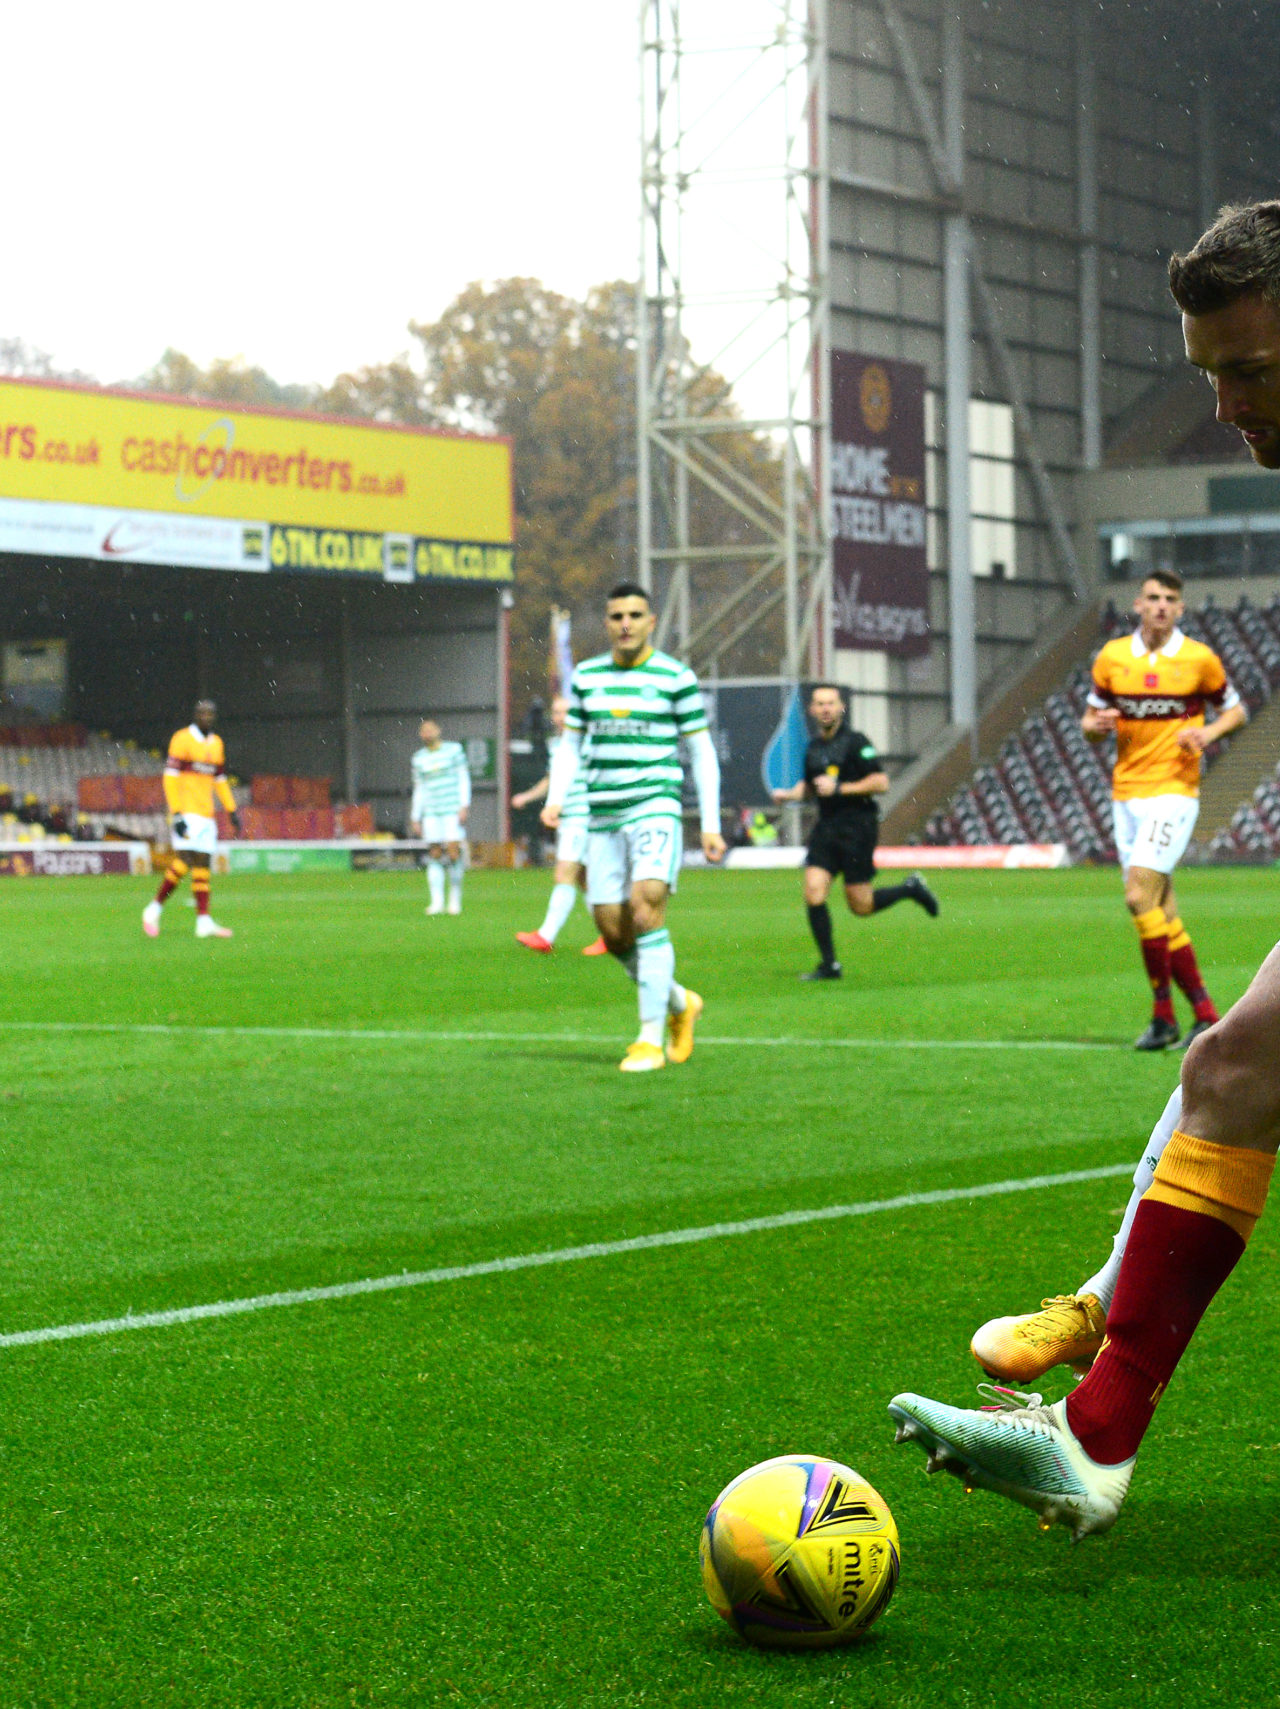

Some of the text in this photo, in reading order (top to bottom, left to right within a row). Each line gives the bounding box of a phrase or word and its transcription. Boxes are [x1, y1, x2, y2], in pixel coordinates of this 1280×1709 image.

[0, 424, 100, 466] rs.co.uk
[640, 829, 668, 856] 27
[1148, 820, 1173, 847] 15
[838, 1541, 864, 1617] mitre
